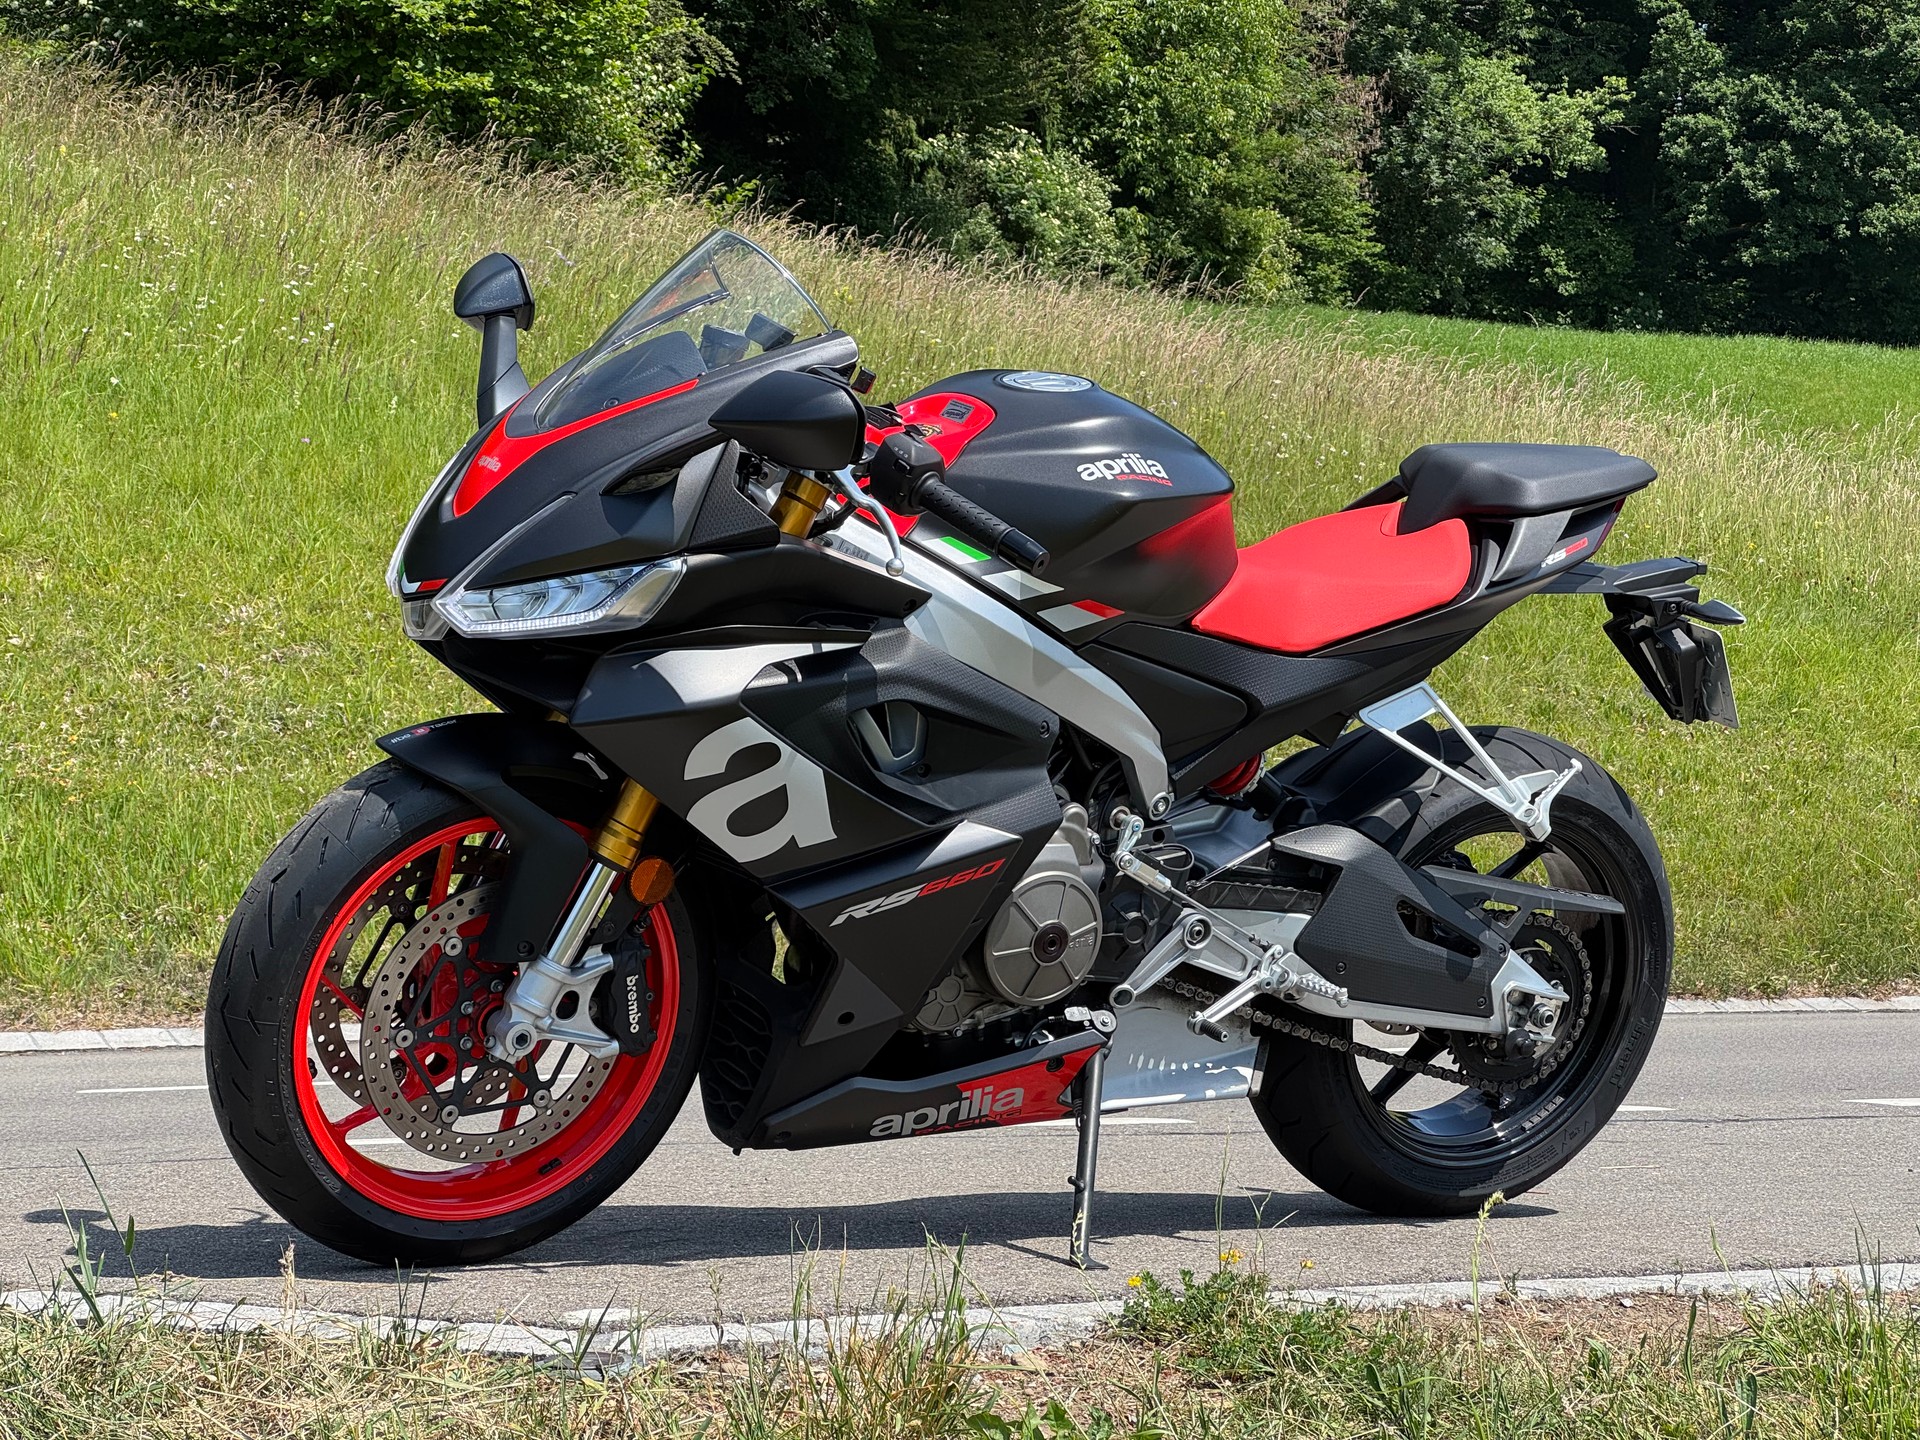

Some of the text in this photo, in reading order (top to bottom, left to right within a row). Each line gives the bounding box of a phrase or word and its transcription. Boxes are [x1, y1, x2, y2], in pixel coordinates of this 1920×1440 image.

[1076, 453, 1169, 481] aprilia
[1115, 474, 1173, 487] RACING
[684, 716, 838, 864] a
[829, 858, 1006, 928] RS660
[626, 974, 642, 1034] brembo
[869, 1085, 1025, 1138] aprilia
[915, 1109, 1022, 1136] RACING
